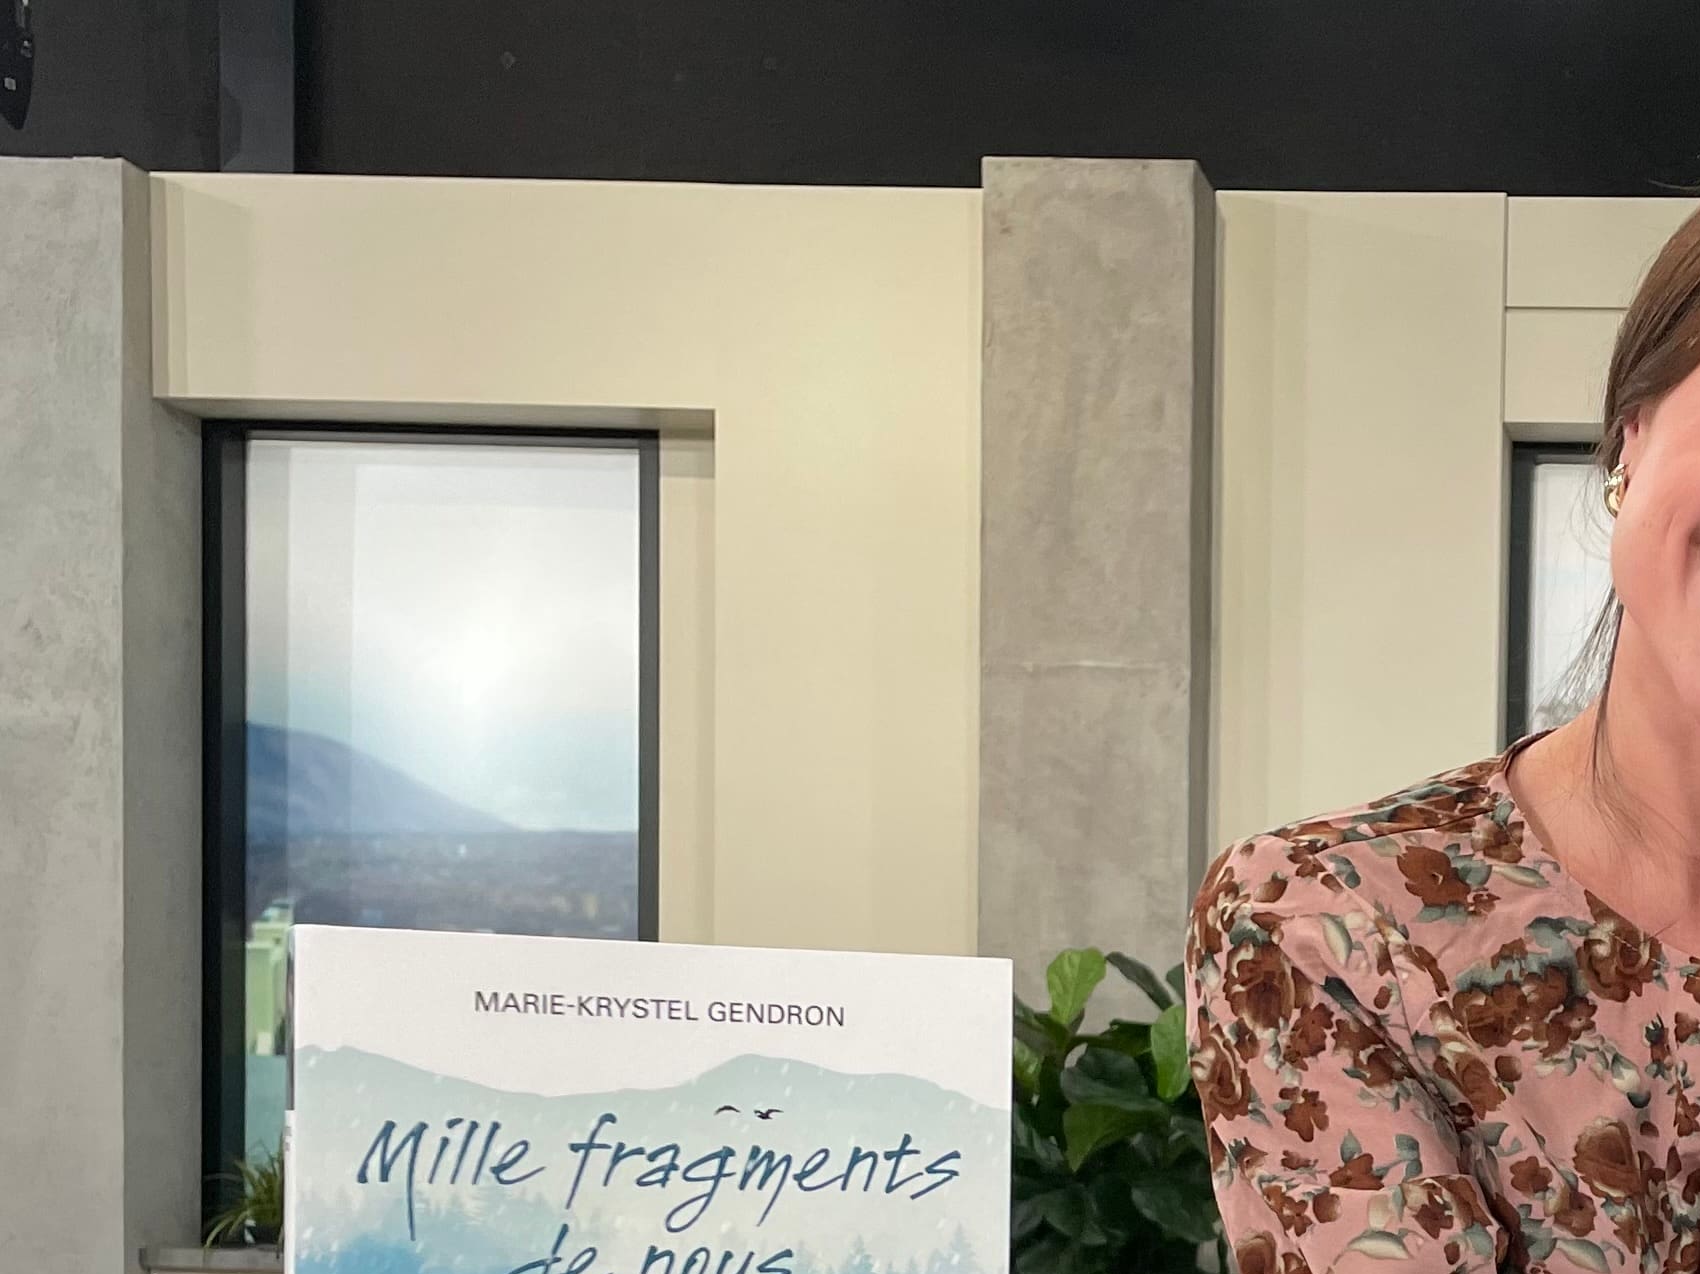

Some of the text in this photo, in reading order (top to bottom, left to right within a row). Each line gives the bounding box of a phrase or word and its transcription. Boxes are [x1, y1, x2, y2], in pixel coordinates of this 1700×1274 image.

[474, 990, 845, 1027] MARIE-KRYSTEL GENDRON
[355, 1112, 962, 1241] Mille fragments
